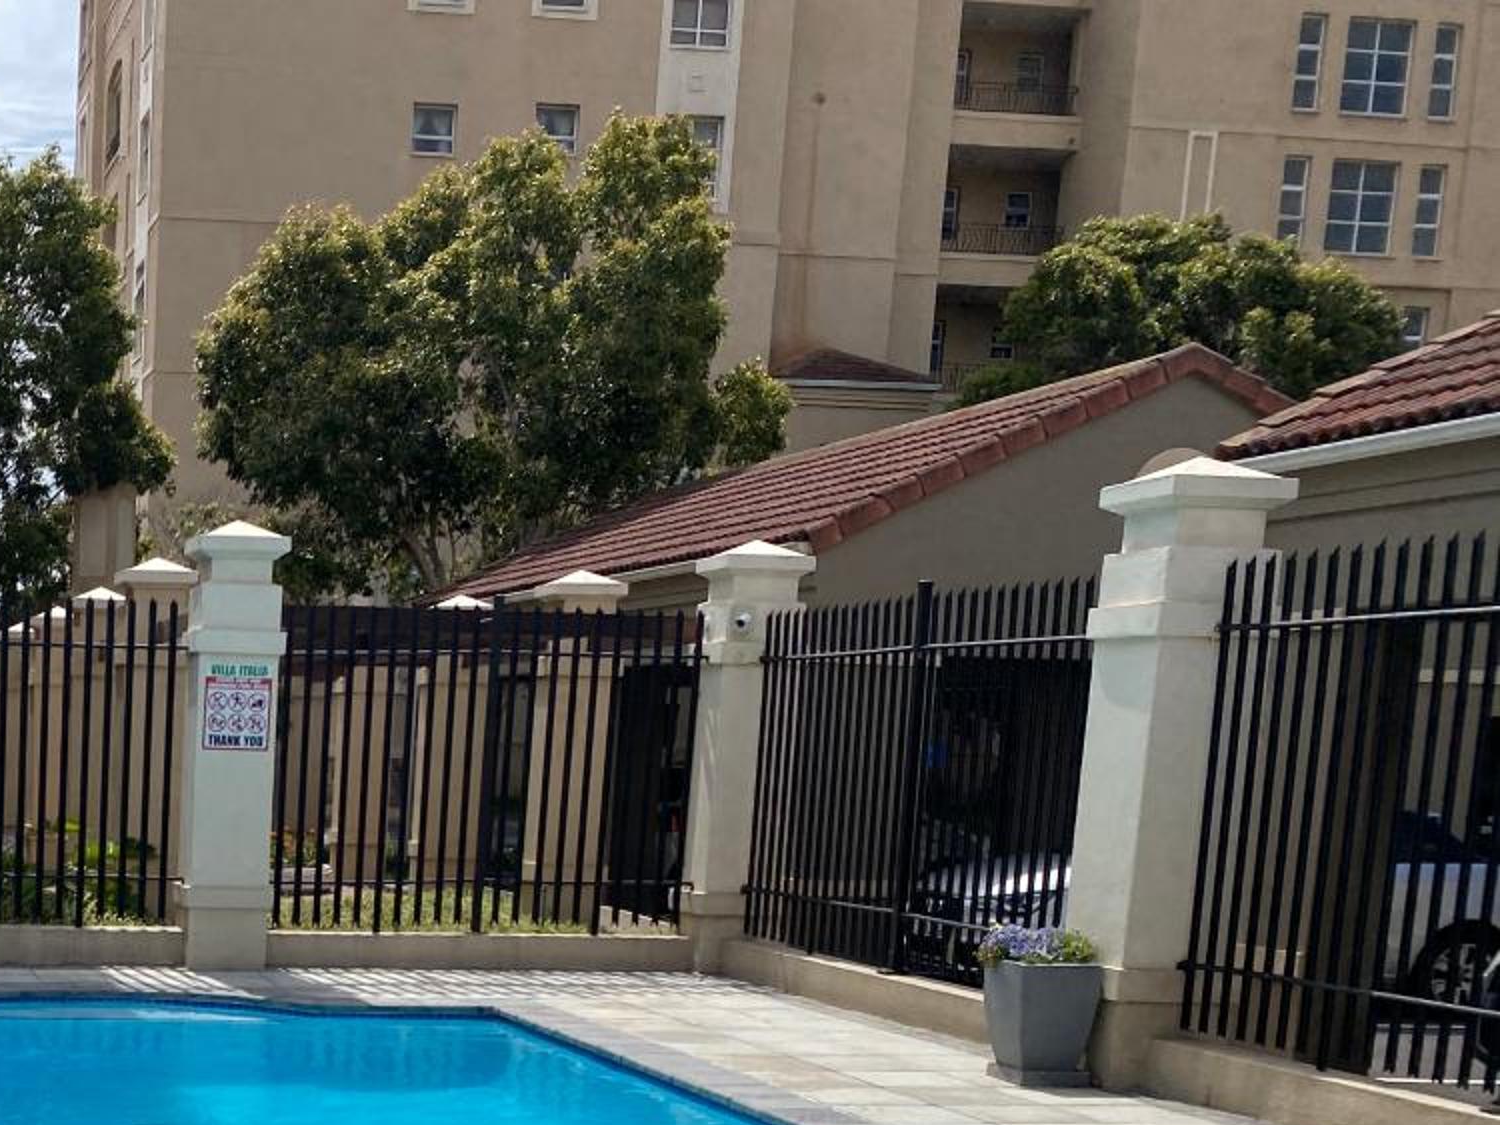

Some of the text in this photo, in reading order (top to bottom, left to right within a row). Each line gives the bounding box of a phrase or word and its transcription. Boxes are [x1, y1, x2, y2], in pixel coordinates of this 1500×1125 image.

[211, 663, 269, 677] VILLA ITALIA
[208, 734, 264, 747] THANK YOU
